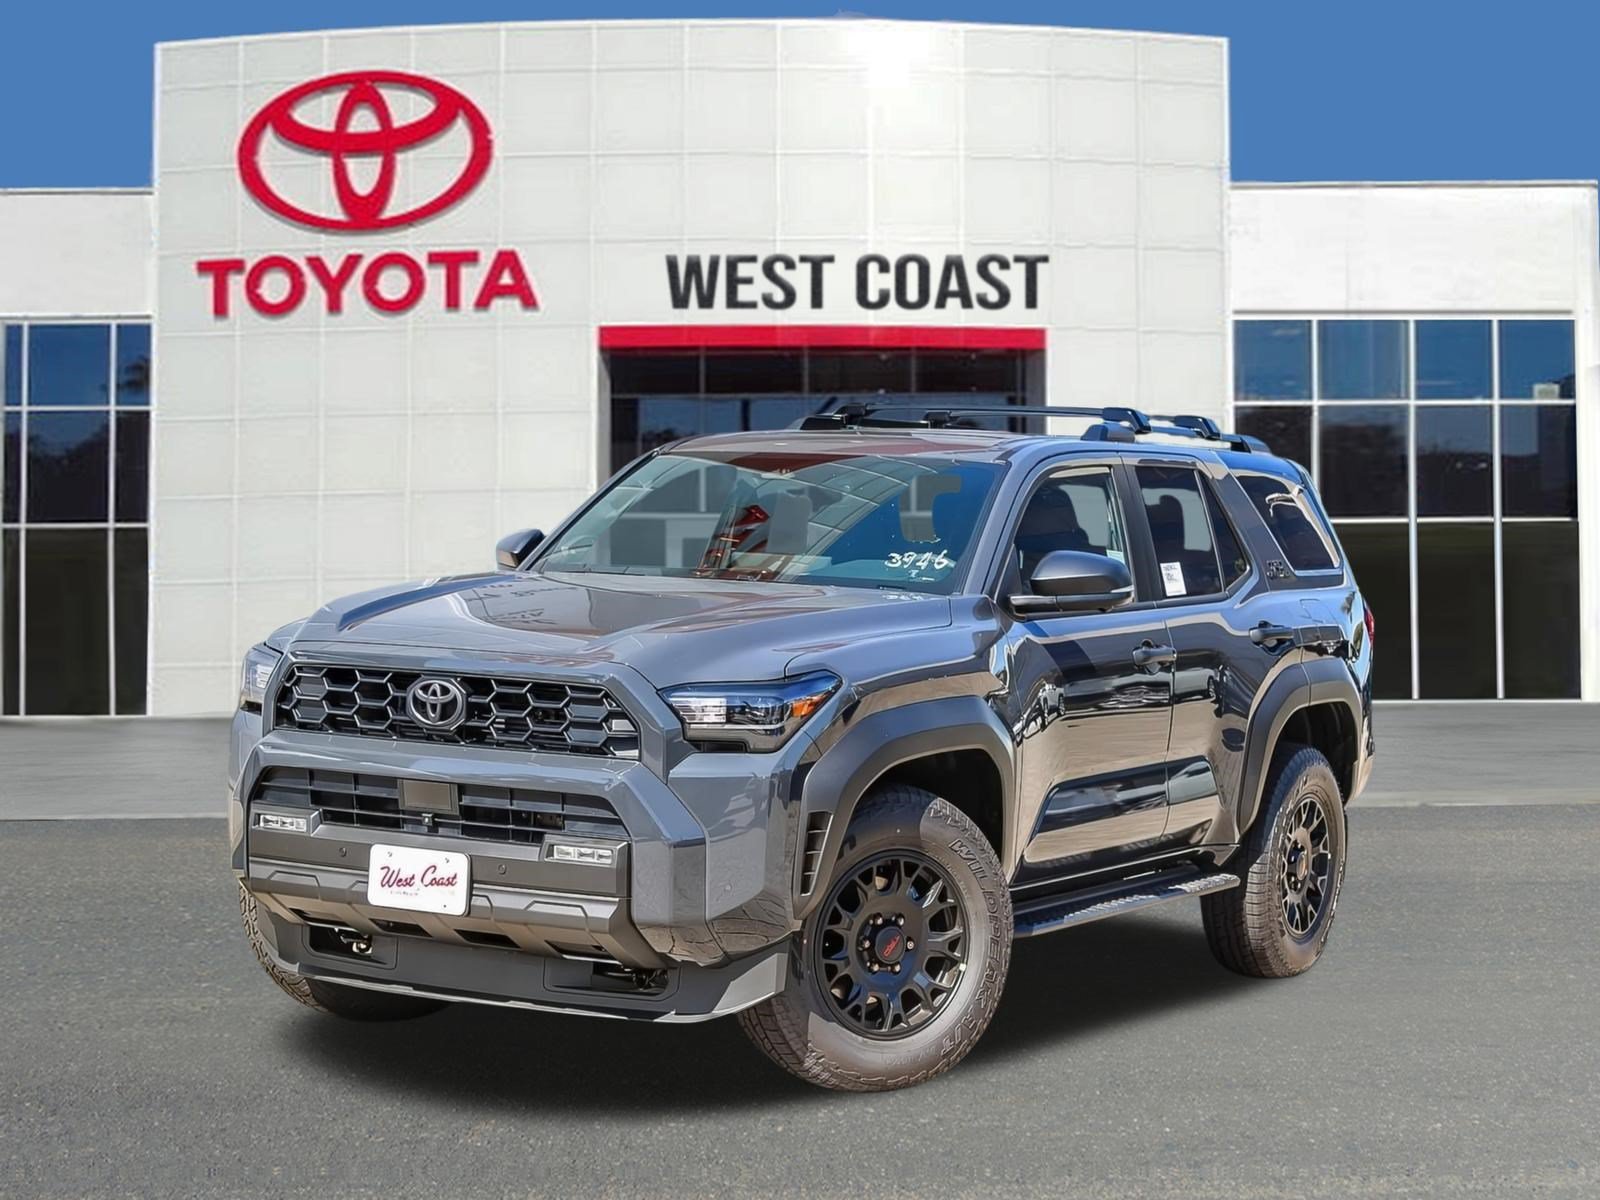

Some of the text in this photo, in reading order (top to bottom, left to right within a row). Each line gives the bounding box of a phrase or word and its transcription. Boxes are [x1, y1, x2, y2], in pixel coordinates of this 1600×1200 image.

[196, 250, 539, 318] TOYOTA
[665, 254, 1050, 310] WEST COAST
[380, 864, 458, 888] West Coast
